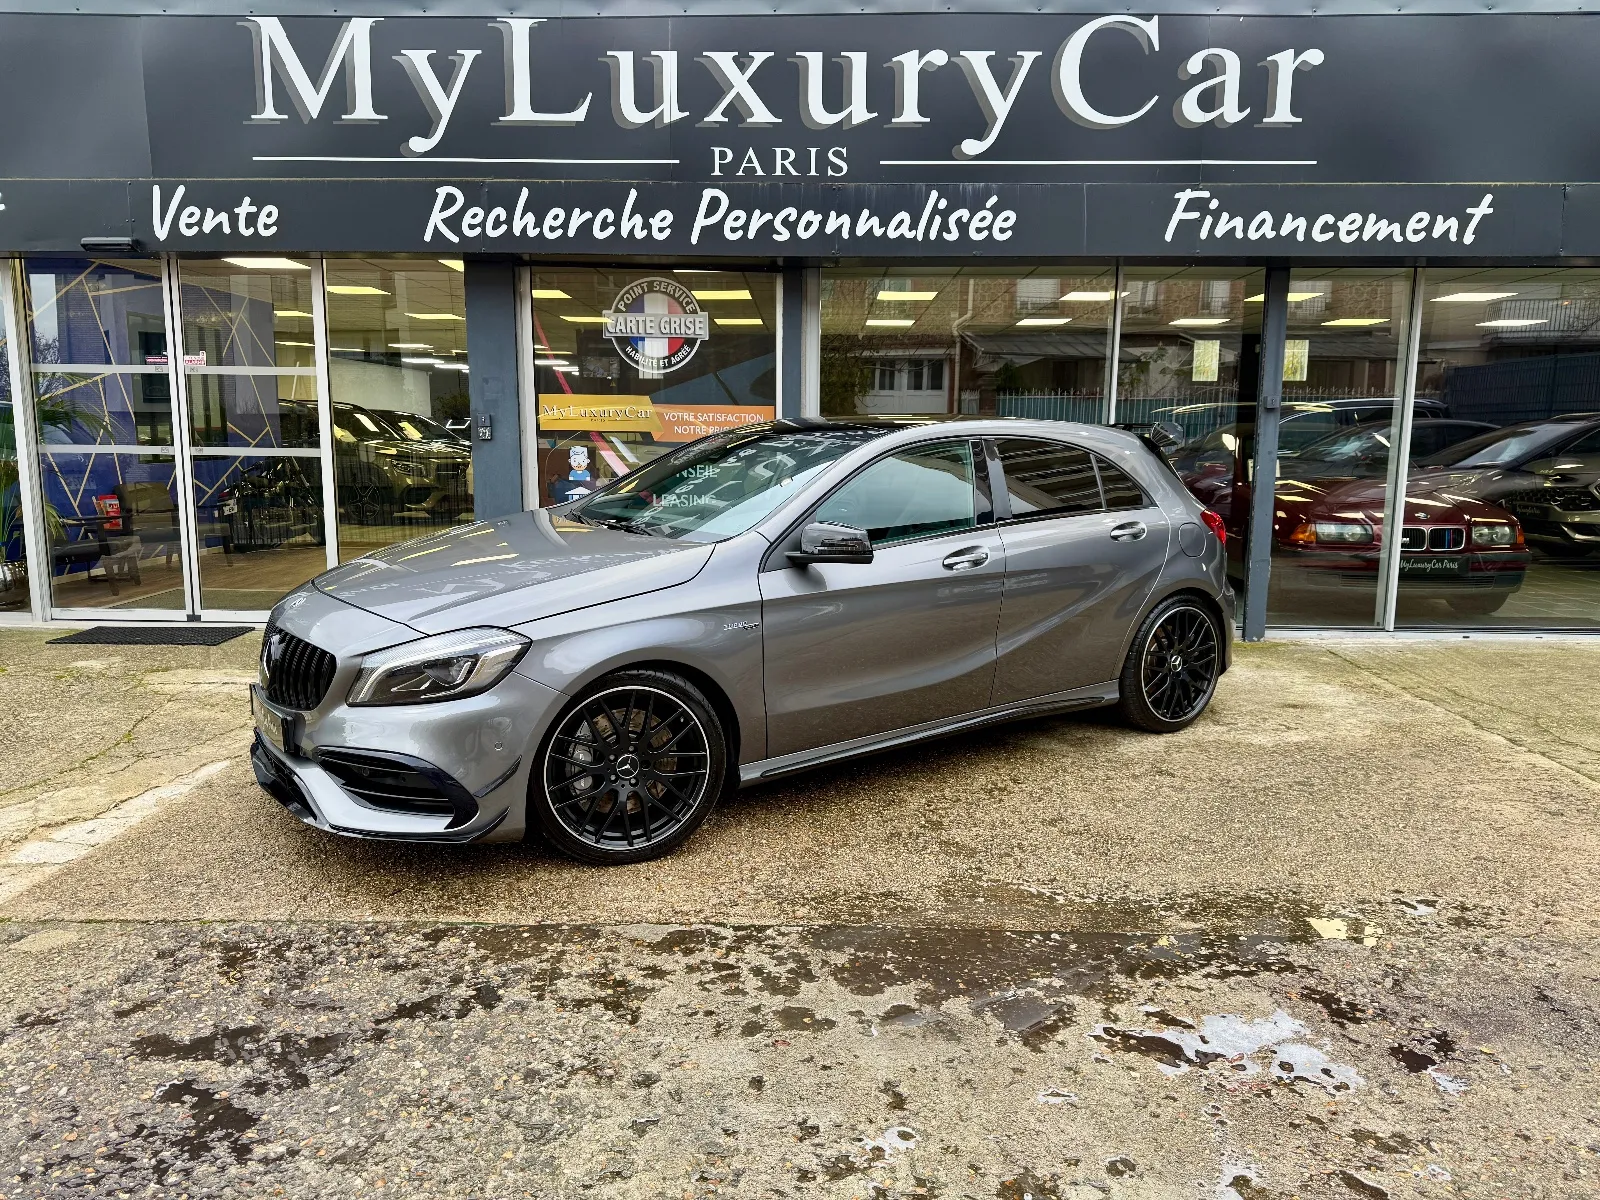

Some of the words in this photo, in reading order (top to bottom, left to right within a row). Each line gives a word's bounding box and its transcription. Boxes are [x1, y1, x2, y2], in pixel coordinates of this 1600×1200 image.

[244, 15, 1325, 156] MyLuxuryCar
[710, 146, 848, 176] PARIS
[152, 184, 279, 242] Vente
[423, 185, 674, 244] Recherche
[690, 187, 1017, 245] Personnalisée
[1164, 188, 1494, 246] Financement
[618, 283, 649, 312] POINT
[653, 281, 696, 314] SERVICE
[606, 316, 655, 334] CARTE
[660, 317, 705, 335] GRISE
[660, 359, 669, 367] ET
[543, 405, 653, 420] MyLuxuryCar
[664, 412, 694, 422] VOTRE
[674, 425, 706, 435] NOTRE
[653, 494, 717, 507] LEASING
